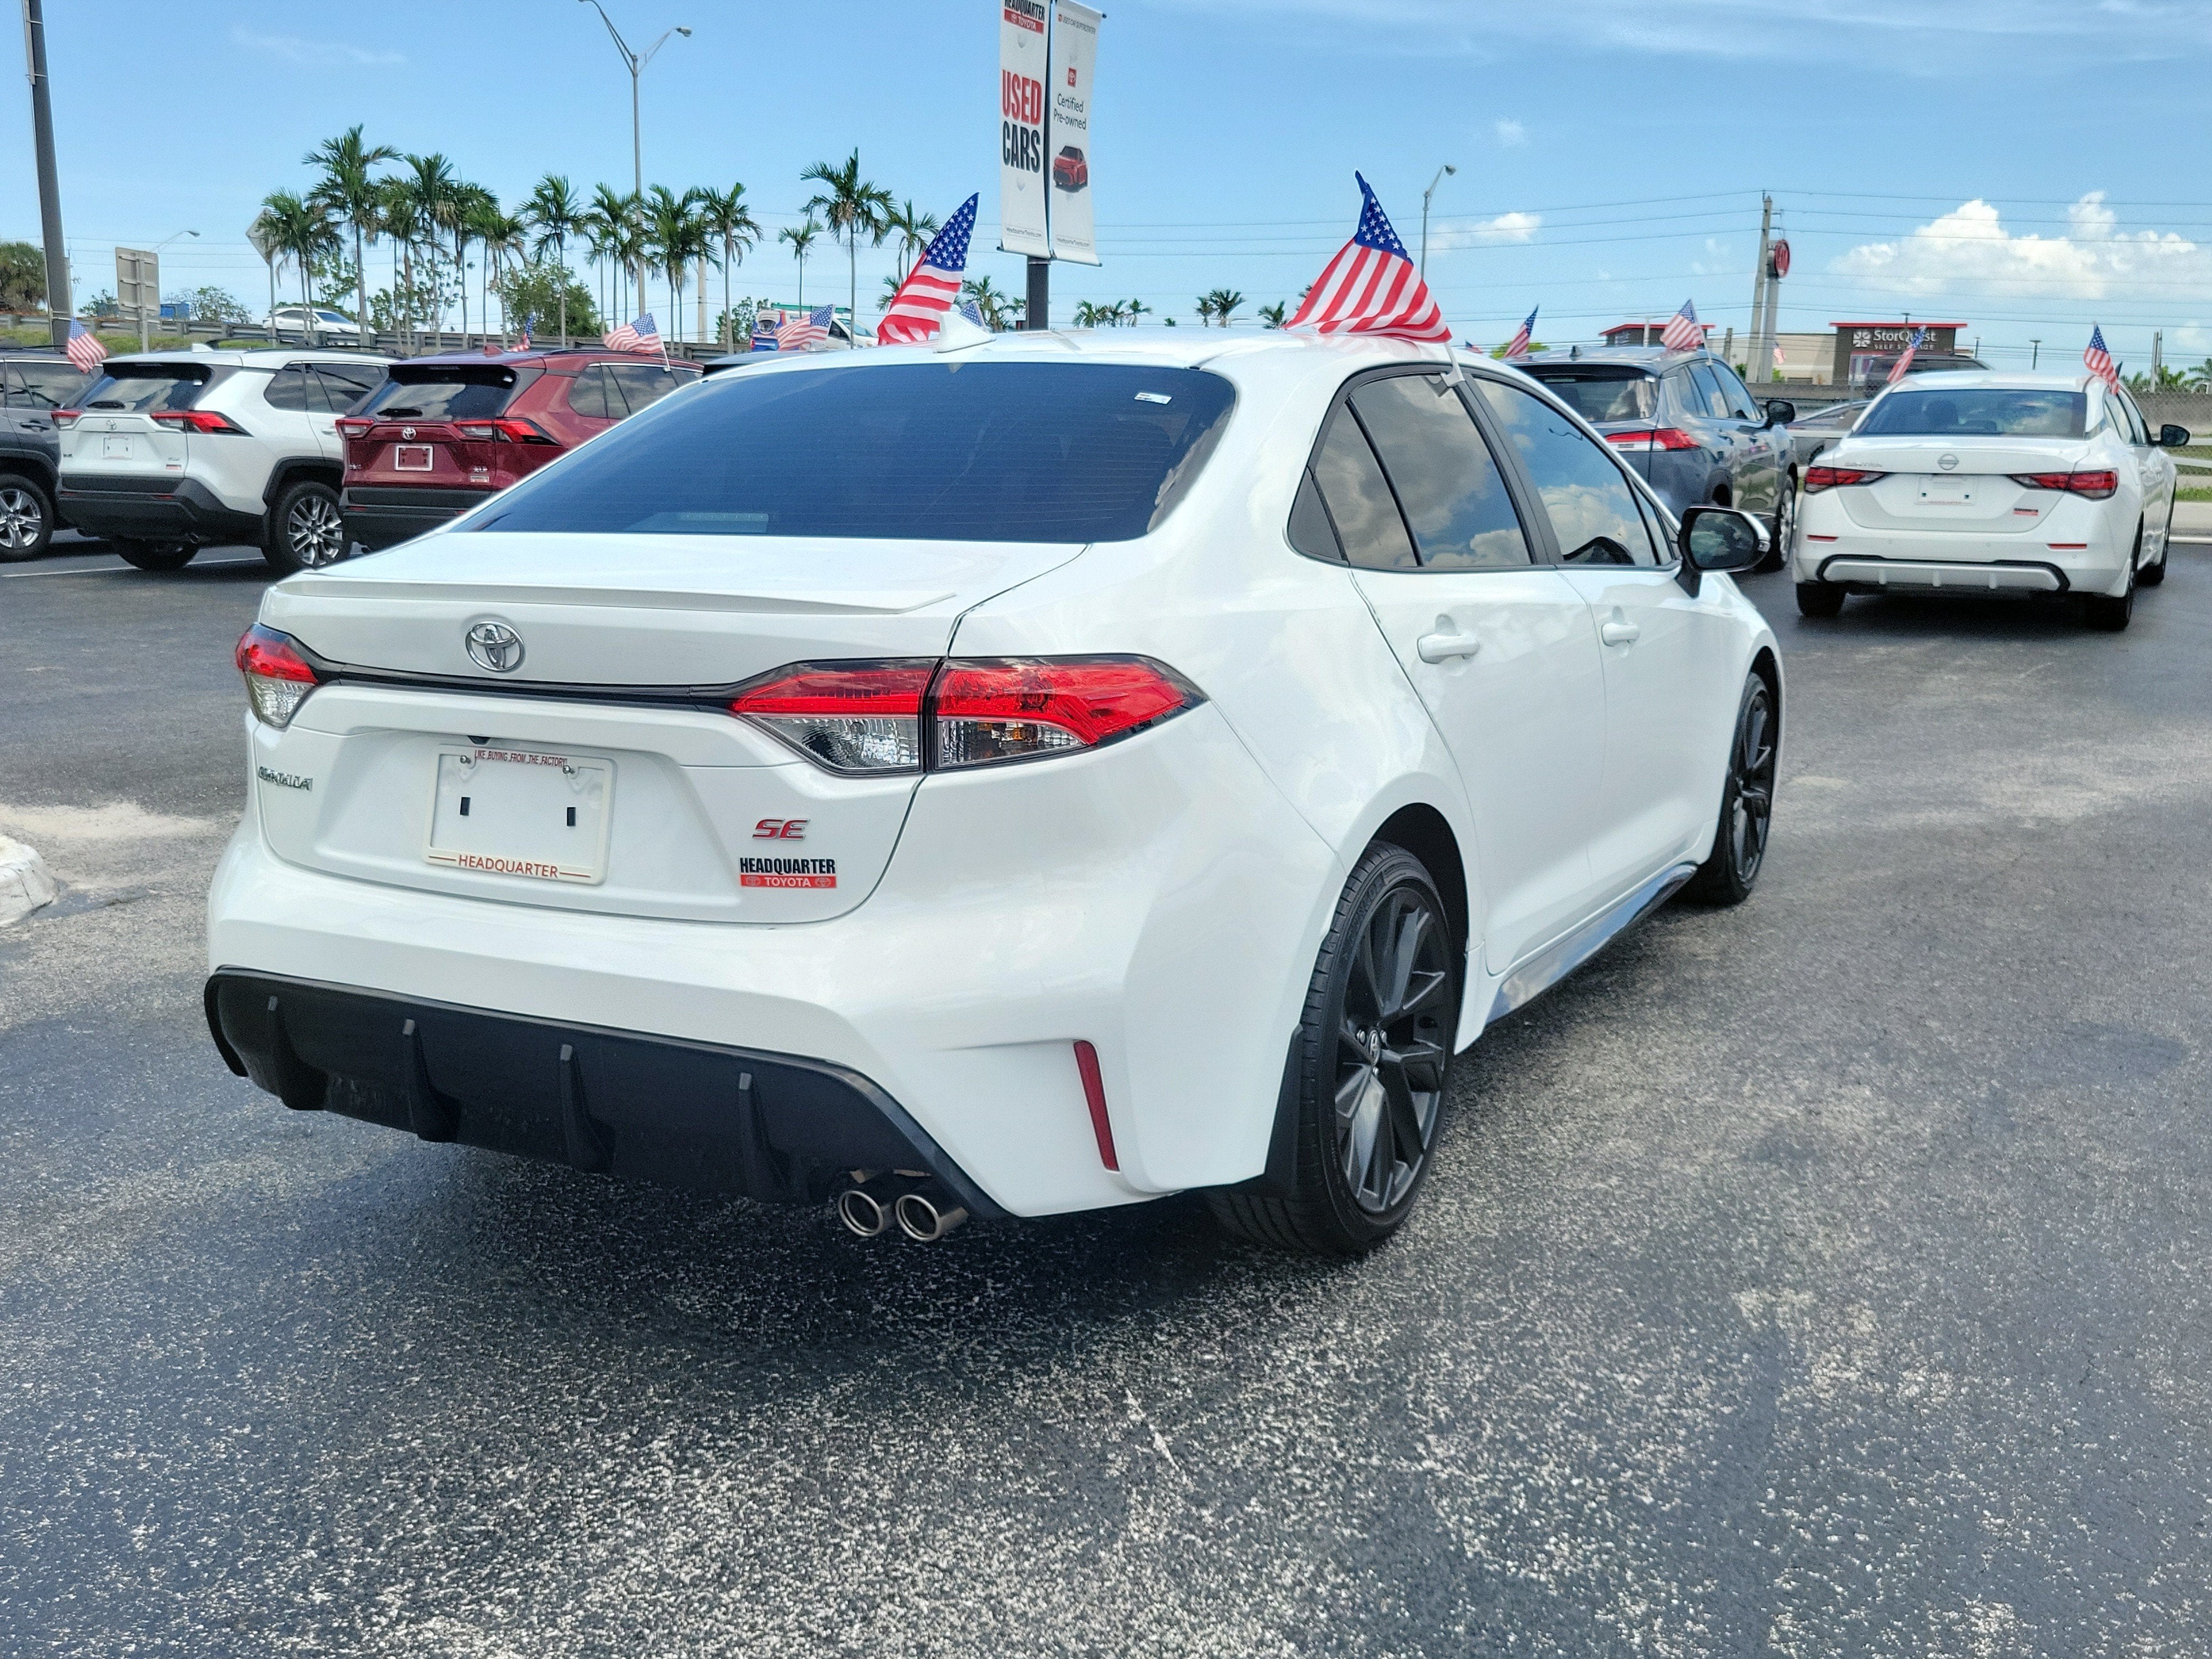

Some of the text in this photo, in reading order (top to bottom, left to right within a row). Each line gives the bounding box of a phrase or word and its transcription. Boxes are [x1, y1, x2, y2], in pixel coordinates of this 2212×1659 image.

[1005, 0, 1045, 21] HEADQUARTER
[1018, 16, 1036, 31] TOYOTA
[1002, 69, 1042, 126] USED
[1057, 93, 1084, 113] Certified
[1054, 109, 1087, 130] Pre-owned
[1003, 121, 1041, 173] CARS
[475, 749, 486, 759] LIKE
[487, 751, 508, 761] BUYING
[509, 753, 526, 763] FROM
[527, 754, 540, 764] THE
[752, 818, 810, 840] SE
[459, 854, 558, 878] HEADQUARTER
[740, 857, 836, 874] HEADQUARTER
[764, 877, 811, 887] TOYOTA
